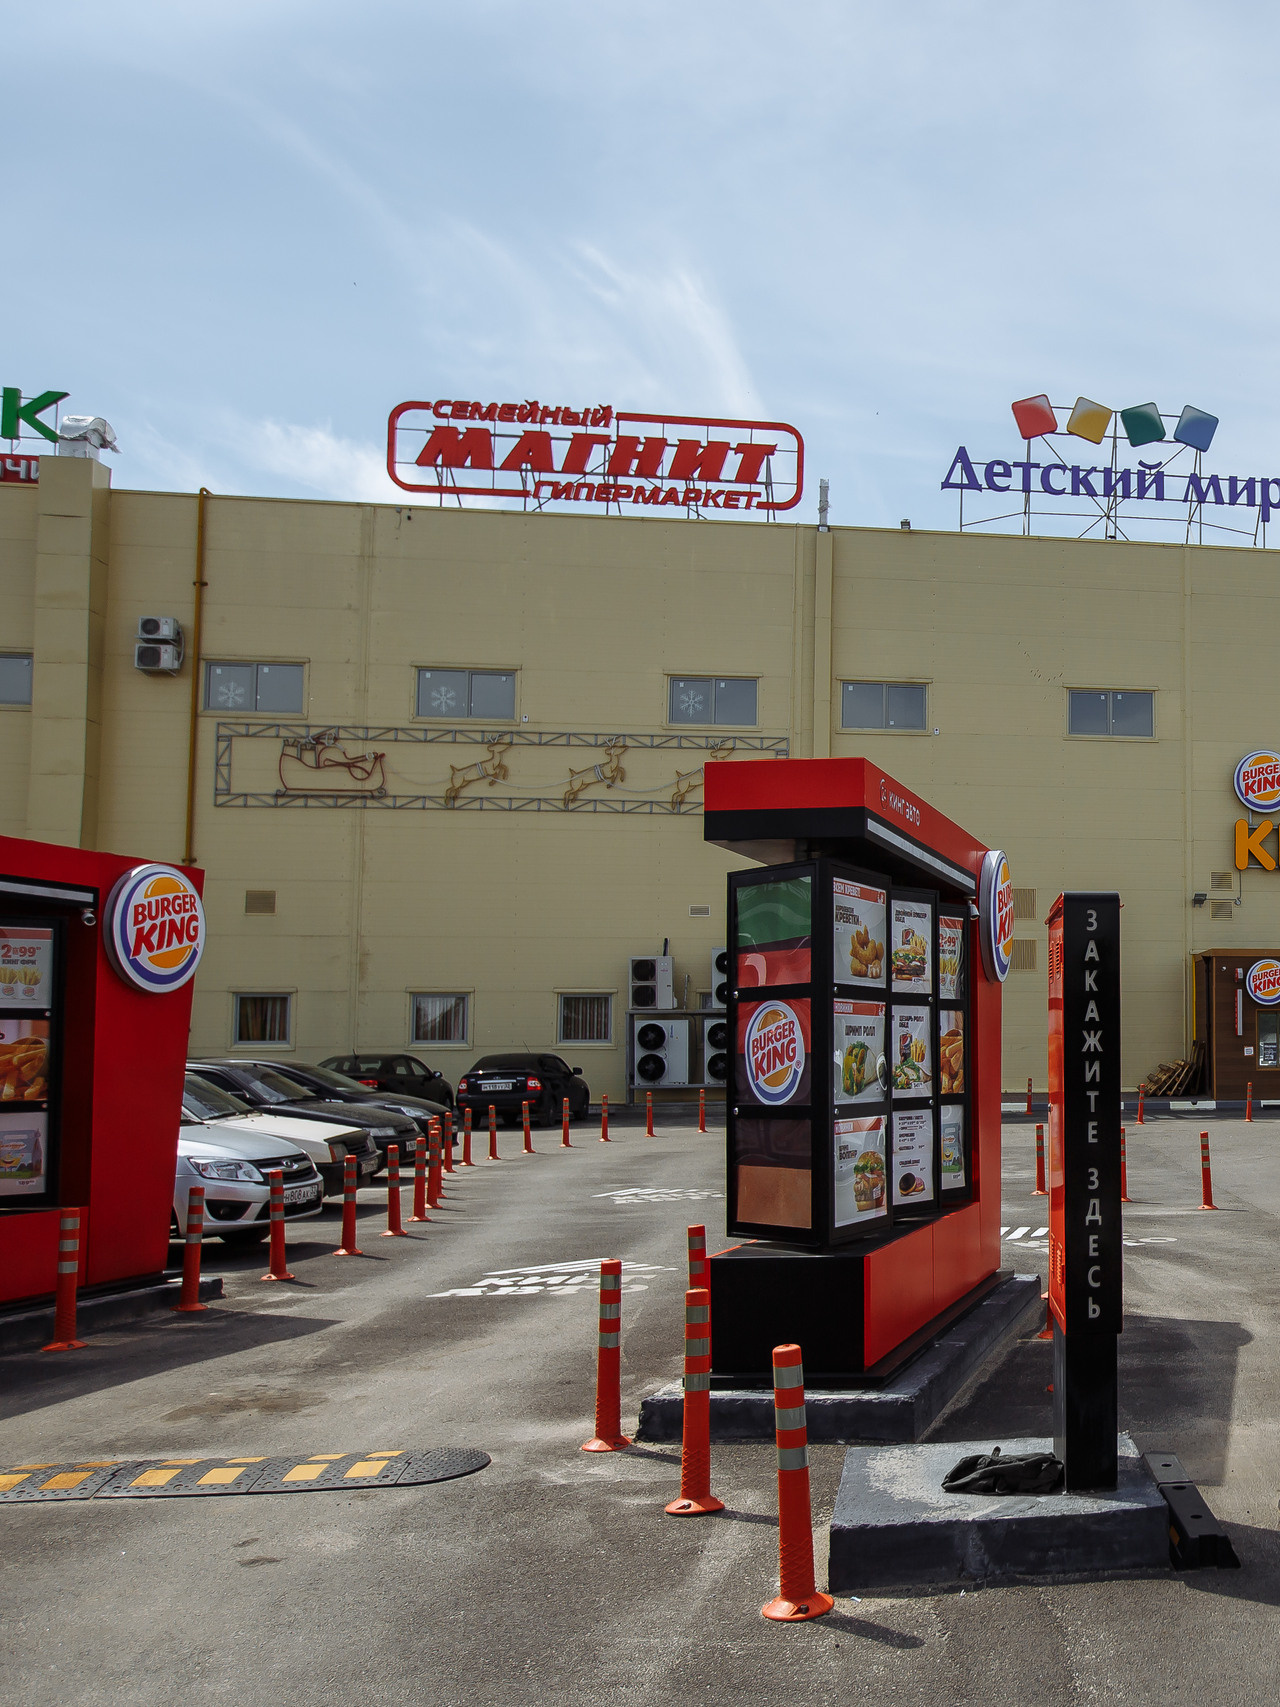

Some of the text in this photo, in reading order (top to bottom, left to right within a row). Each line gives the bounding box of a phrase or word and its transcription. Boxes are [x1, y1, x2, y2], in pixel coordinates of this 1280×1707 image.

[432, 400, 613, 428] СЕМЕЙНЫЙ
[416, 425, 778, 484] МАГНИТ
[941, 446, 1165, 501] Детский
[533, 480, 761, 510] ГИПЕРМАРКЕТ
[133, 893, 198, 927] BURGER
[131, 913, 199, 960] KING
[751, 1019, 796, 1059] BURGER
[754, 1037, 797, 1084] KING
[1082, 909, 1104, 1319] ЗАКАЖИТЕ ЗДЕСЬ
